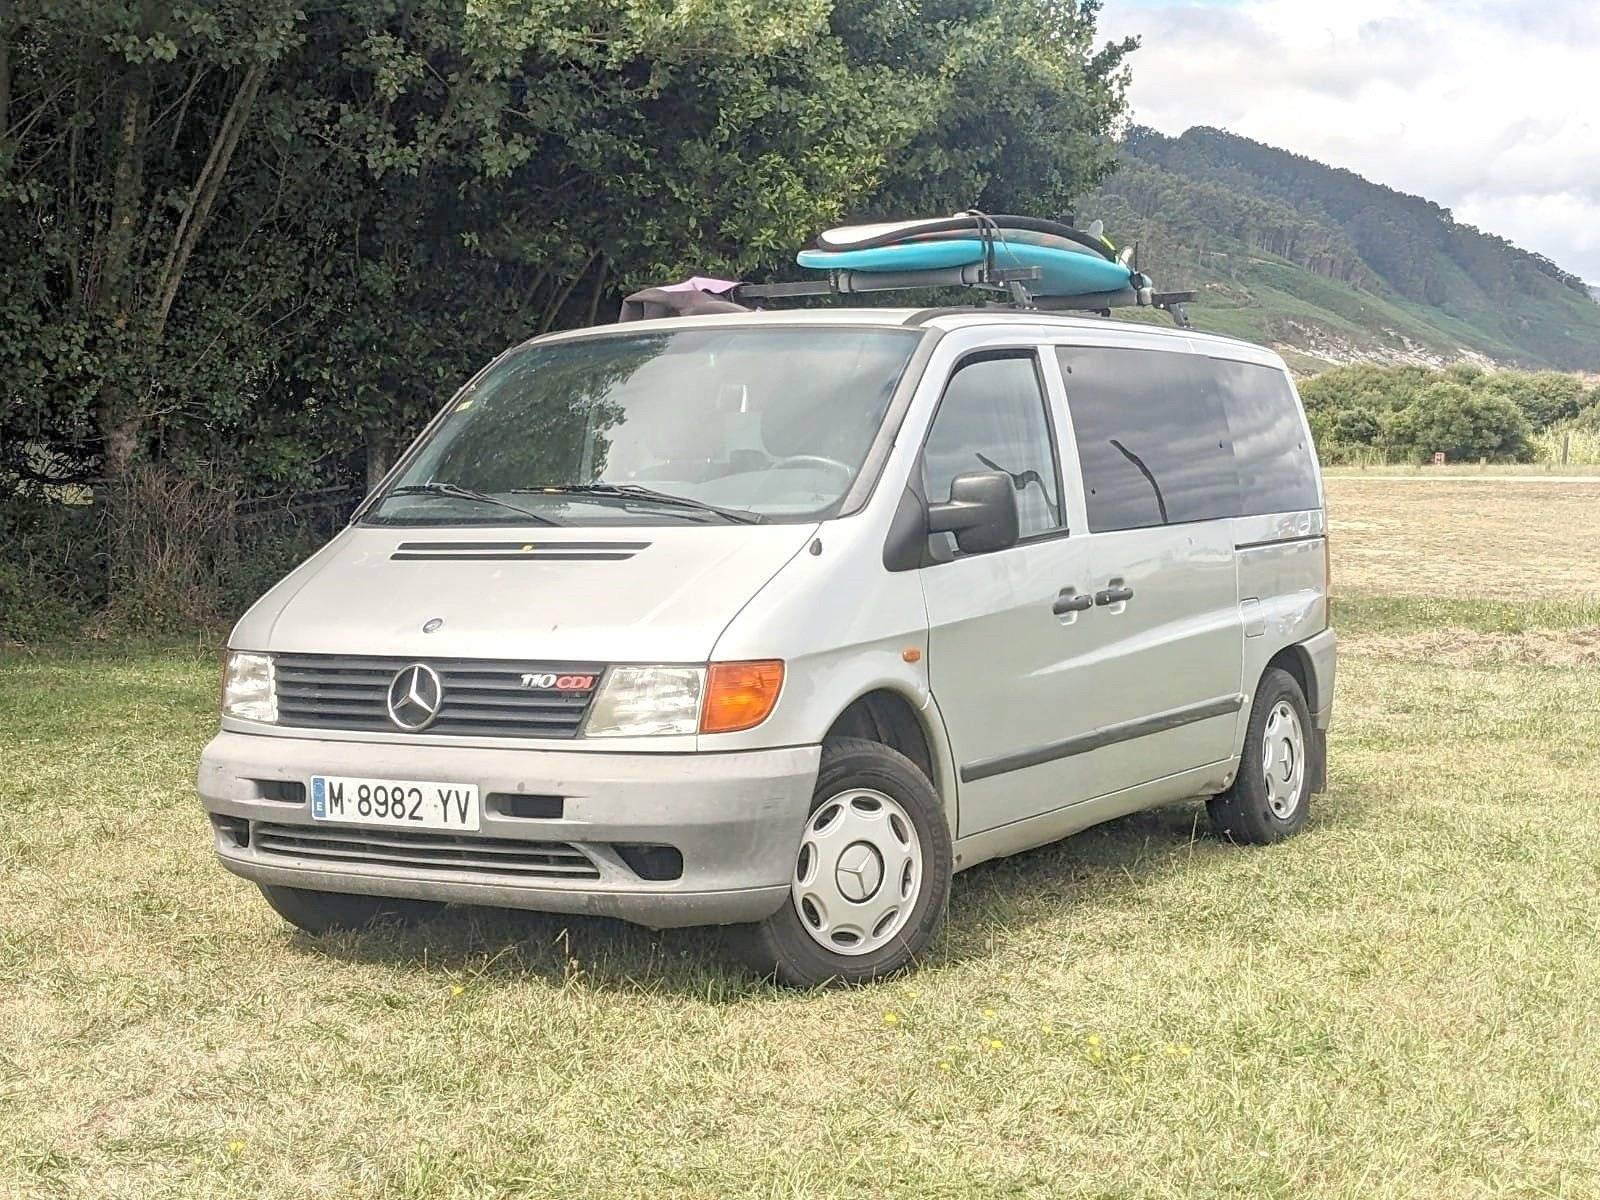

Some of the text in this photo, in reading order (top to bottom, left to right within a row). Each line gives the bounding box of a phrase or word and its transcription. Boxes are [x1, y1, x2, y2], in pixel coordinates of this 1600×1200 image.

[316, 801, 323, 811] E
[329, 781, 470, 824] M 8982 YV
